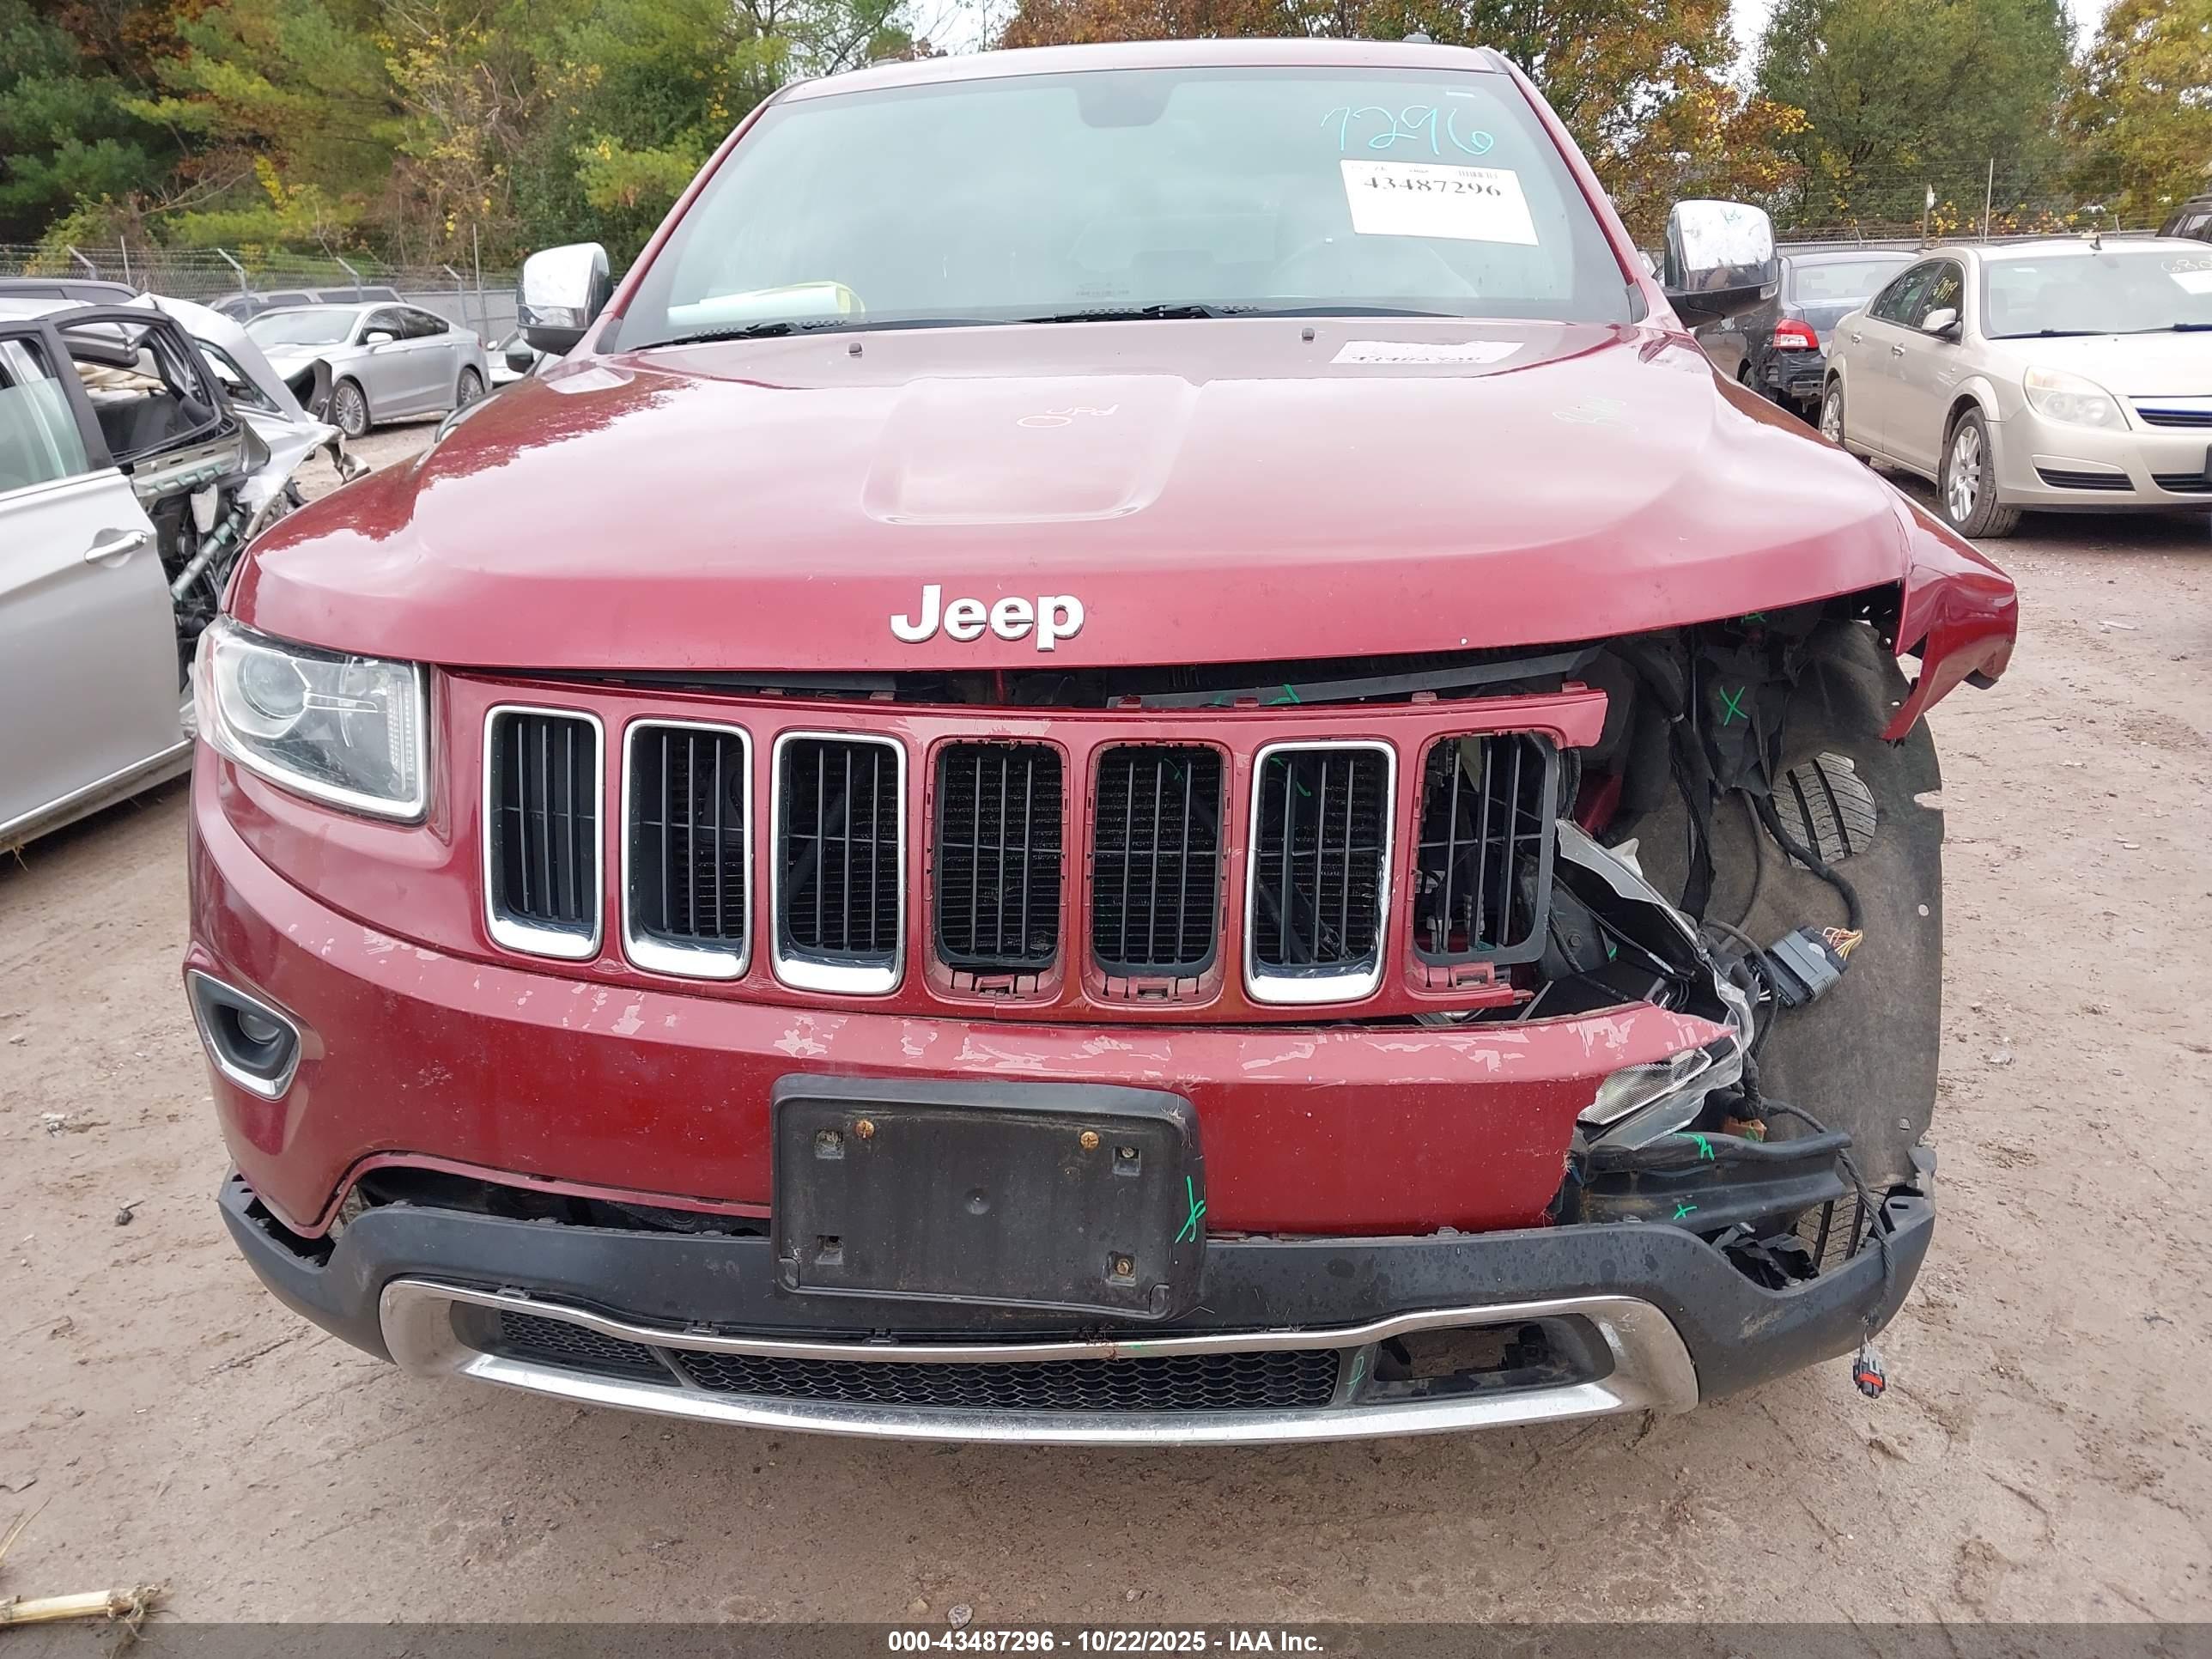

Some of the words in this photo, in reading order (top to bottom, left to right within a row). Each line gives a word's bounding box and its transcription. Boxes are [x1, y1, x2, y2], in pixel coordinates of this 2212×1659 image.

[1321, 105, 1494, 155] 7296
[1364, 175, 1502, 197] 43487296
[890, 583, 1085, 653] Jeep
